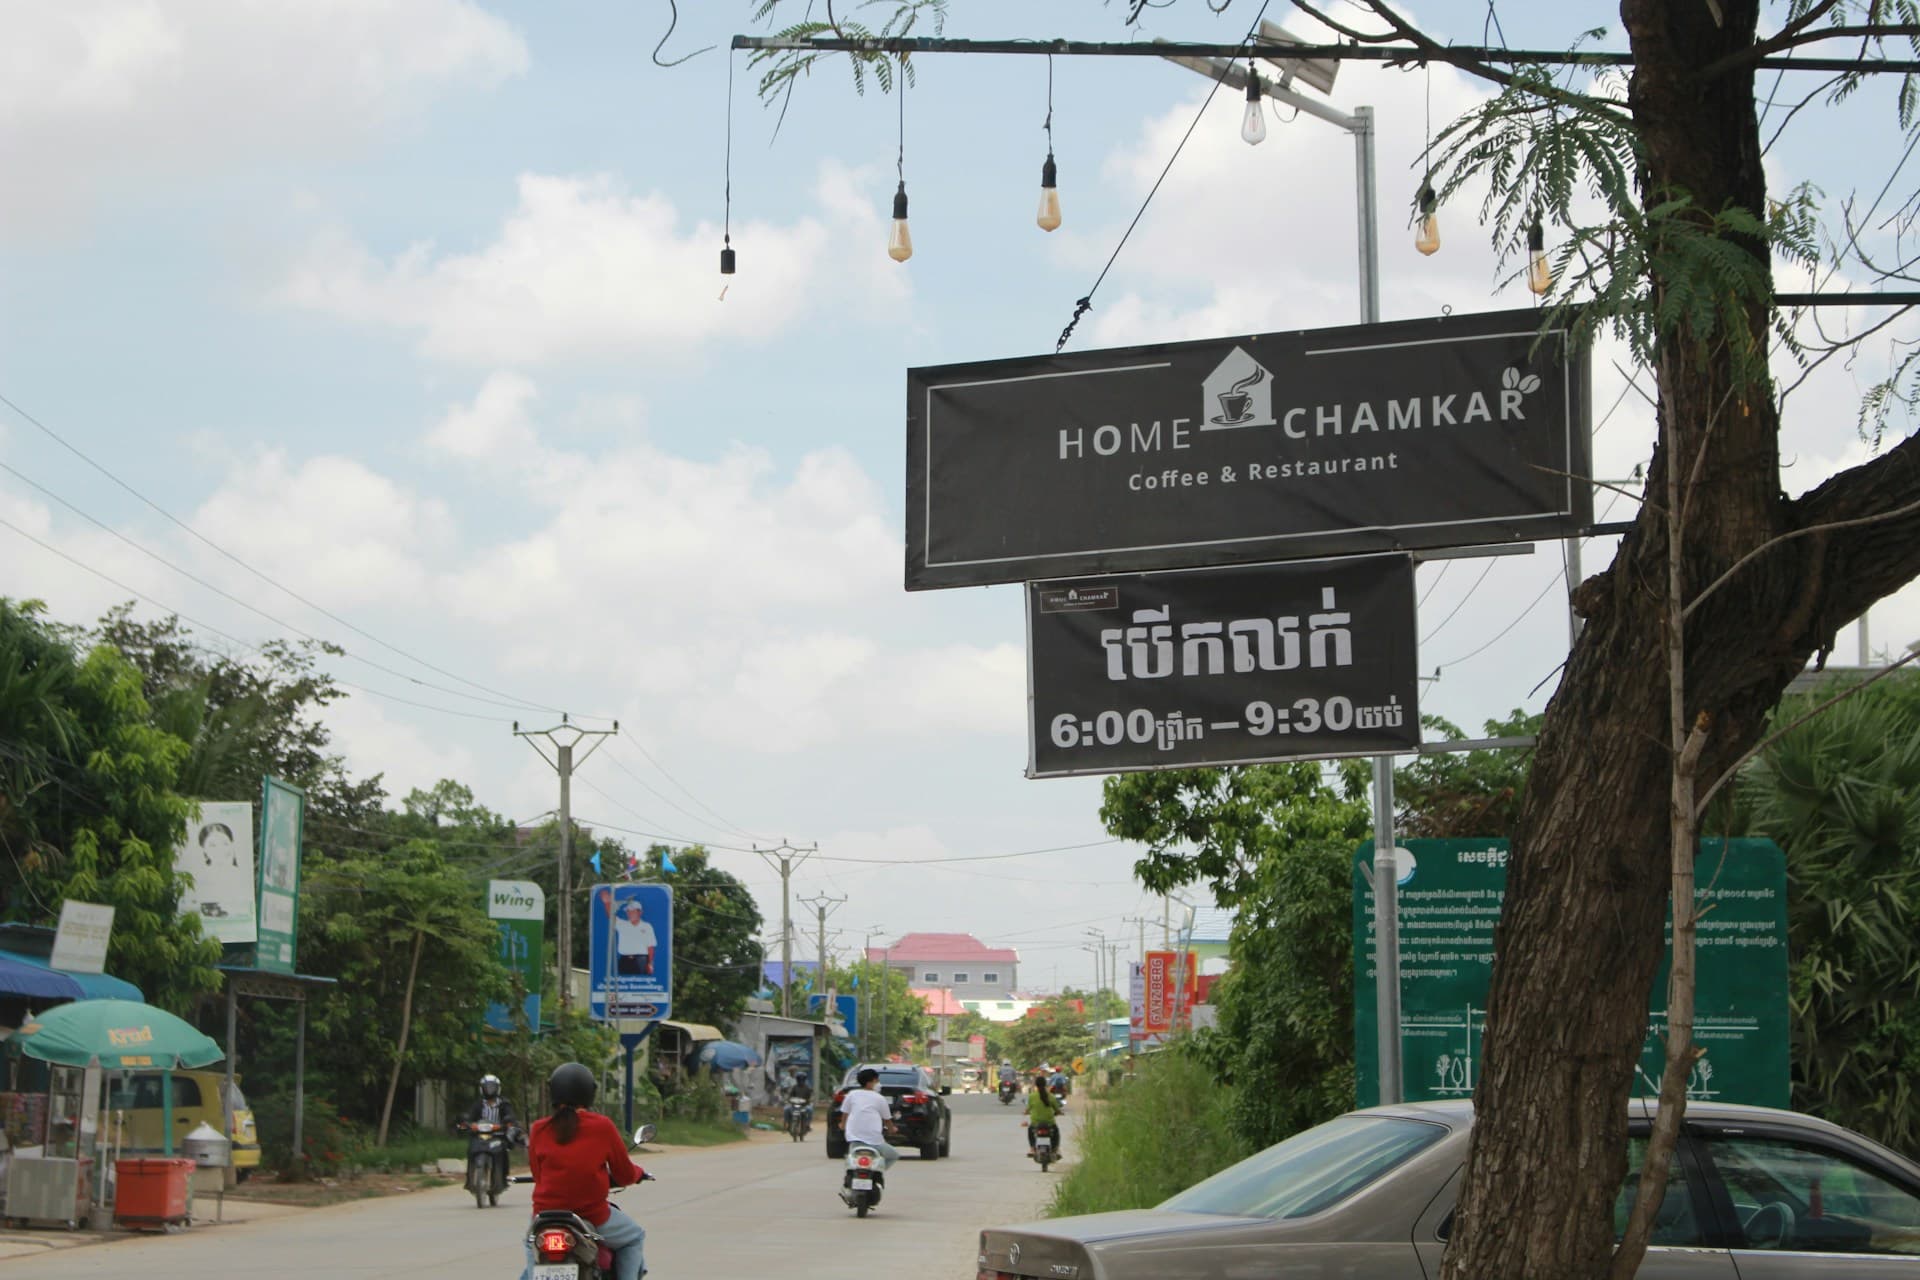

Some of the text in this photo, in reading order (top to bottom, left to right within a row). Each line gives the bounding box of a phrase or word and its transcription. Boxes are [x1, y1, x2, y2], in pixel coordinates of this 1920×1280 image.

[1059, 390, 1526, 460] HOME CHAMKAR
[1128, 452, 1398, 491] Coffee & Restaurant
[1101, 587, 1352, 681] បើកលក់
[495, 893, 535, 911] Wing
[1151, 958, 1163, 1025] GANZBERG
